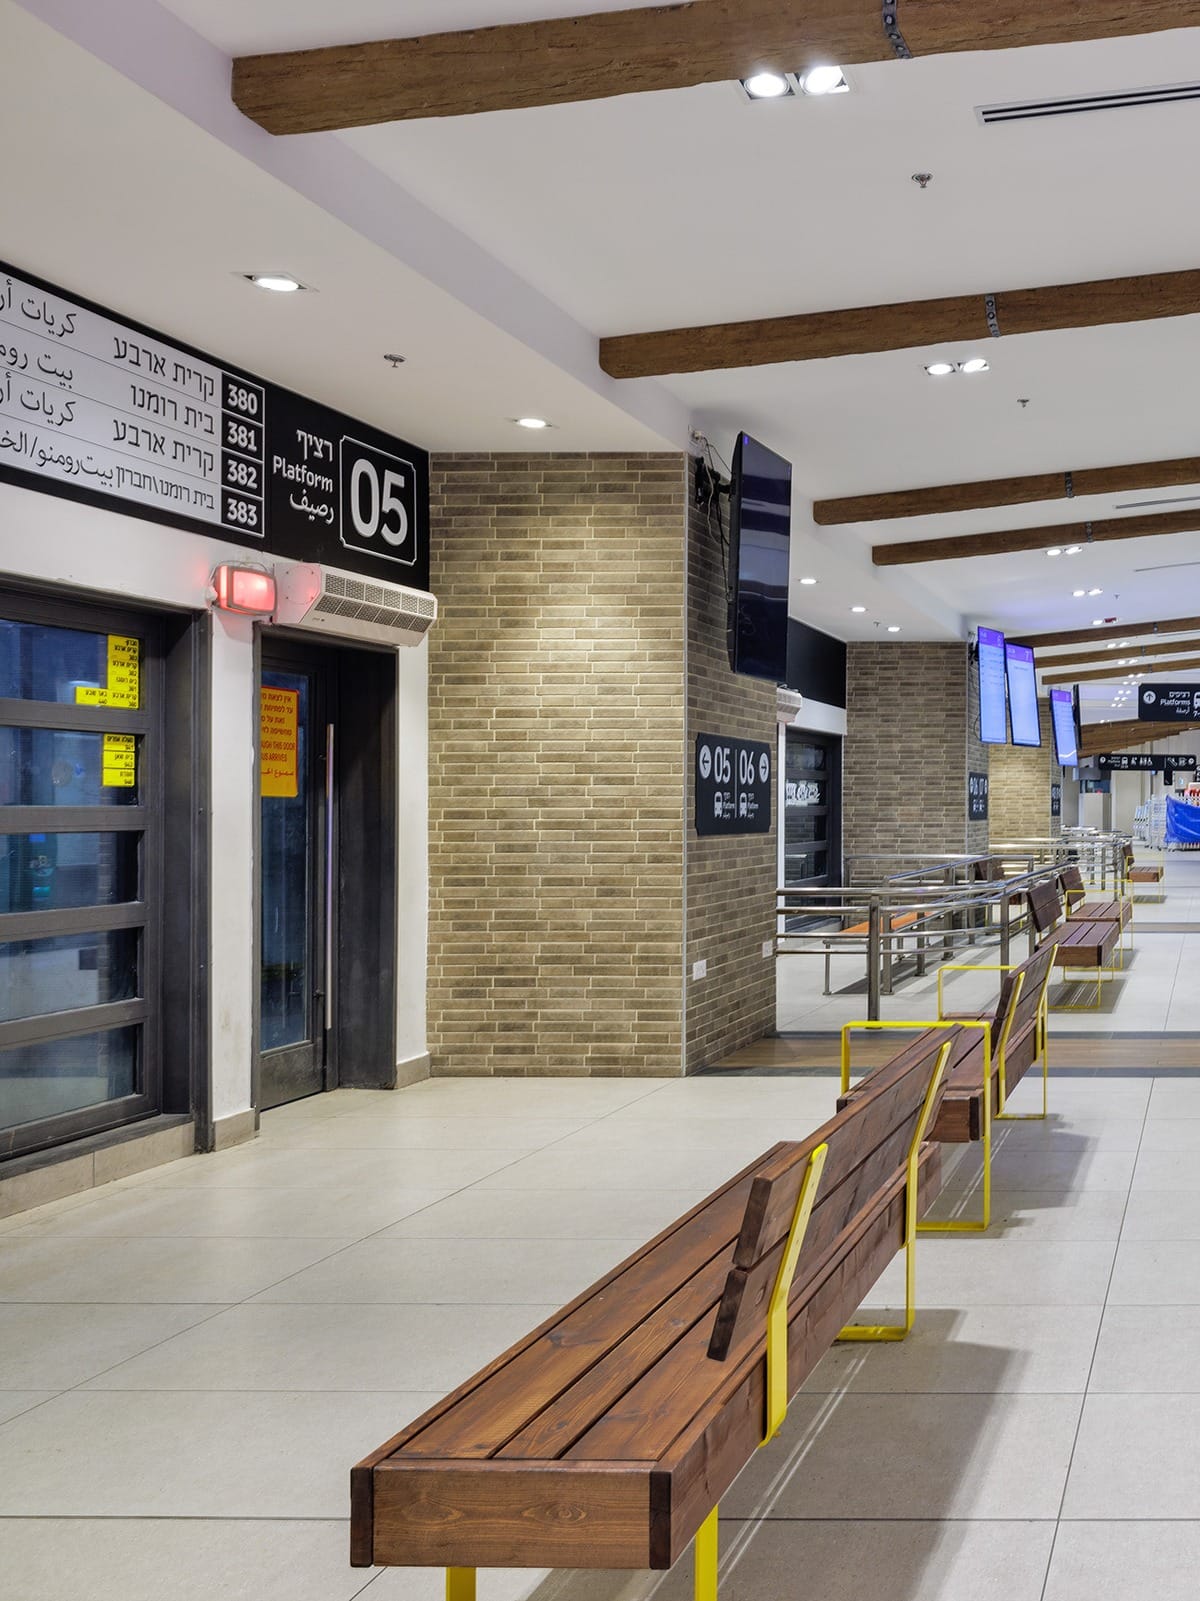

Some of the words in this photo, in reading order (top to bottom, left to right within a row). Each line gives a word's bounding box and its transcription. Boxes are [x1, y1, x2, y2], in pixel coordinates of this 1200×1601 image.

[21, 298, 77, 337] كريات
[0, 343, 28, 370] روم
[37, 353, 74, 389] بيت
[113, 337, 167, 378] ארבע
[172, 362, 215, 402] קרית
[227, 383, 258, 416] 380
[20, 389, 77, 427] كريات
[130, 384, 178, 422] רומנו
[184, 405, 216, 435] בית
[112, 419, 167, 456] ארבע
[226, 421, 257, 452] 381
[296, 429, 333, 463] רציף
[171, 440, 215, 478] קרית
[226, 459, 258, 490] 382
[272, 454, 333, 493] Platform
[192, 489, 216, 510] בית
[226, 497, 258, 527] 383
[289, 488, 335, 525] رصيف
[350, 458, 408, 547] 05
[1160, 698, 1190, 706] Platforms
[714, 746, 731, 784] 05
[740, 749, 755, 785] 06
